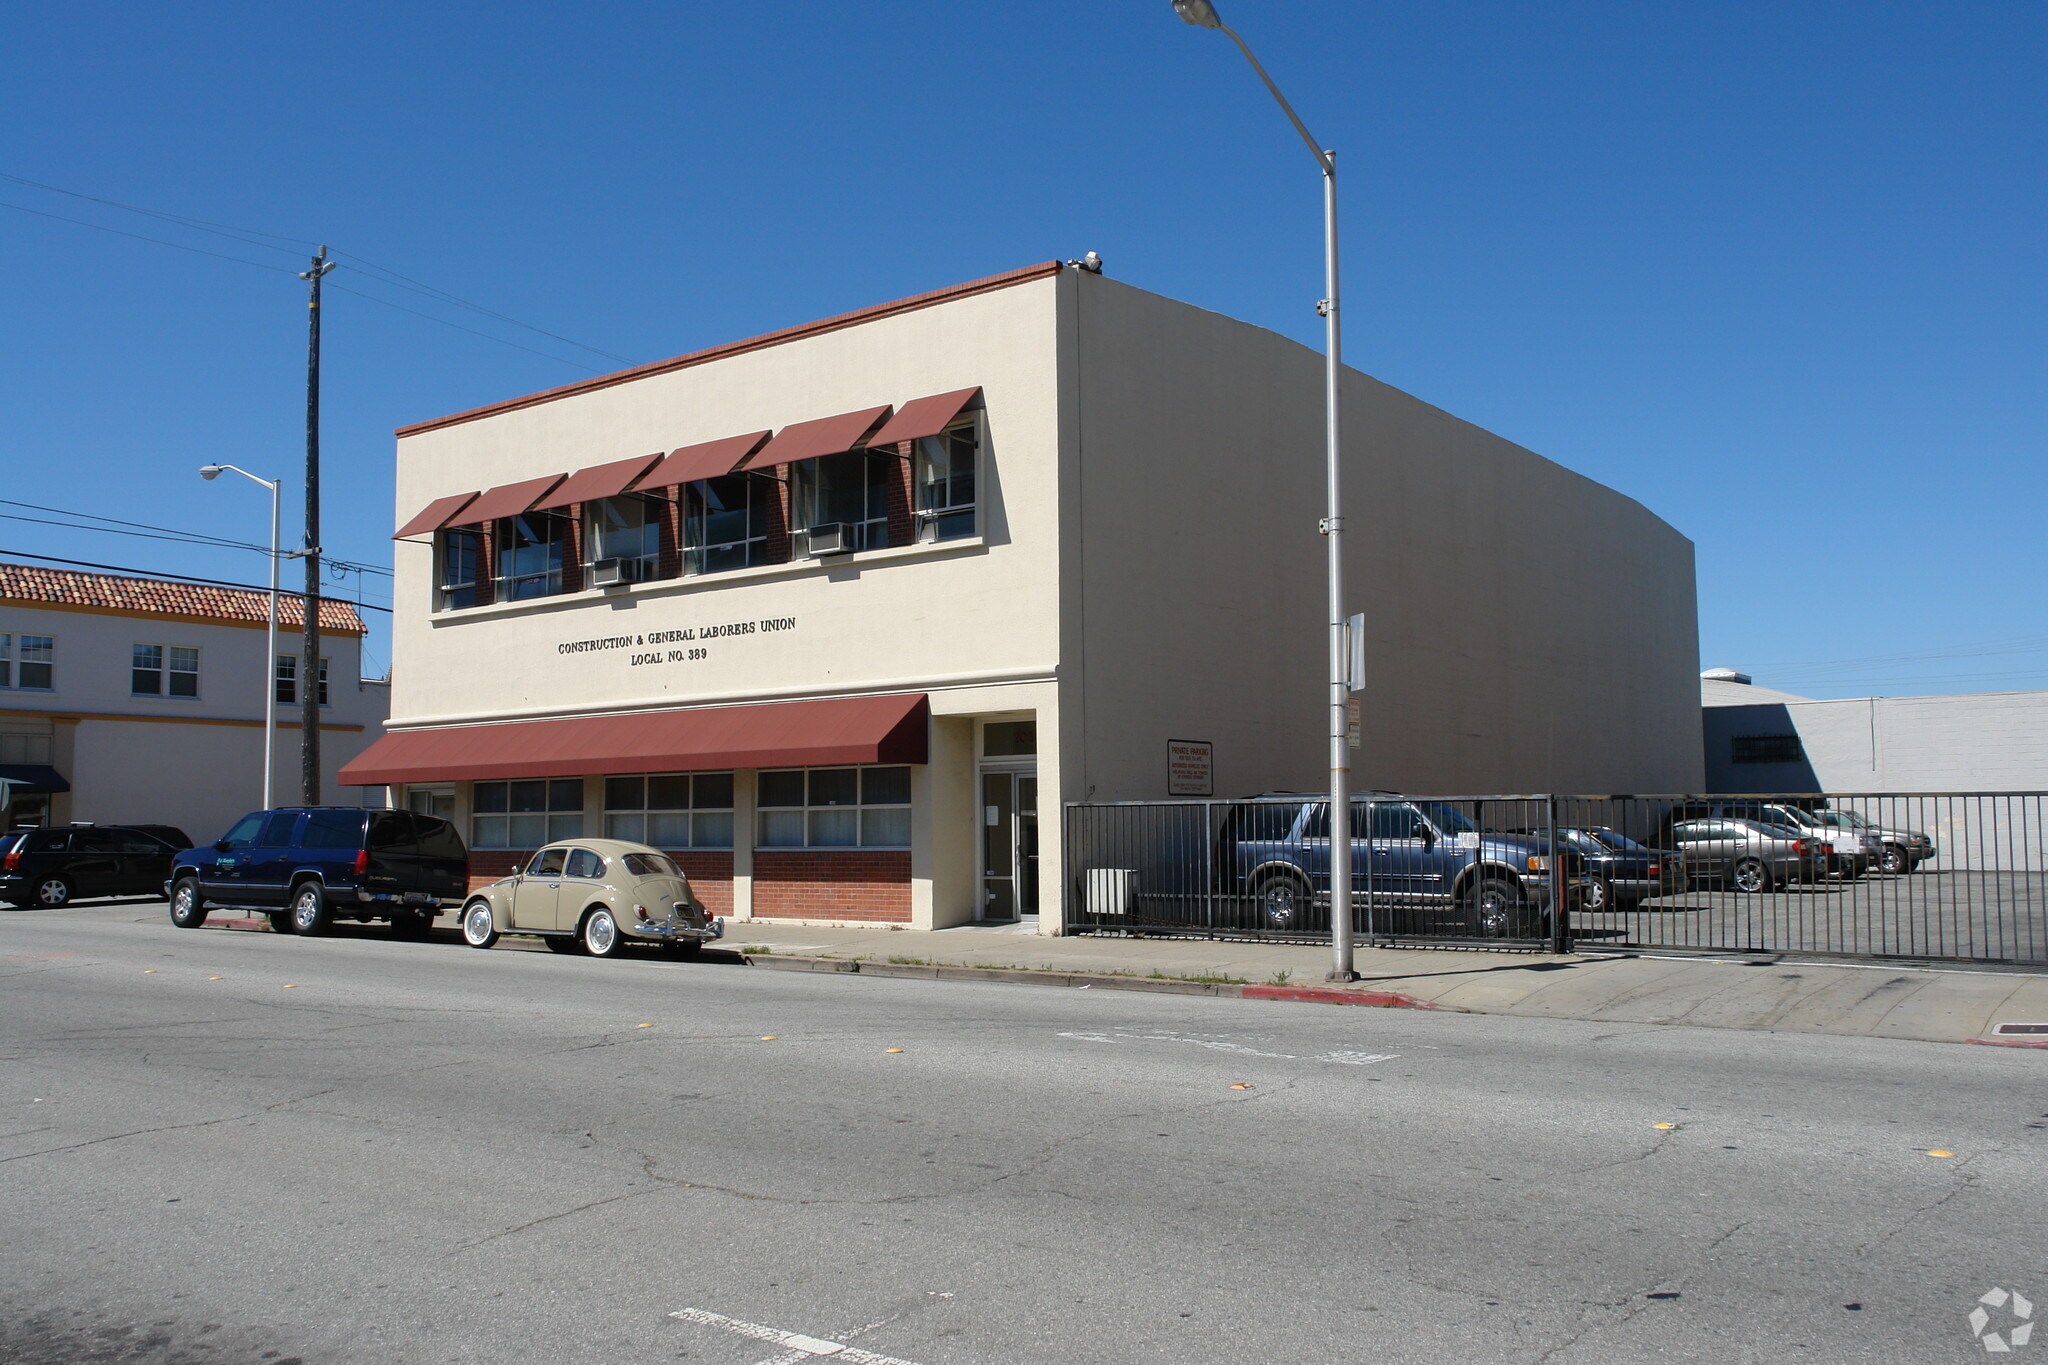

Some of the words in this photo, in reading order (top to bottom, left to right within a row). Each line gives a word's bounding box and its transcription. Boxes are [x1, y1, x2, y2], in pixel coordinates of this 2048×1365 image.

[558, 635, 633, 655] CONSTRUCTION
[636, 634, 644, 646] &
[648, 628, 696, 646] GENERAL
[700, 621, 757, 639] LABORERS
[760, 617, 796, 634] UNION
[631, 651, 663, 666] LOCAL
[668, 650, 685, 663] NO.
[688, 647, 707, 661] 389
